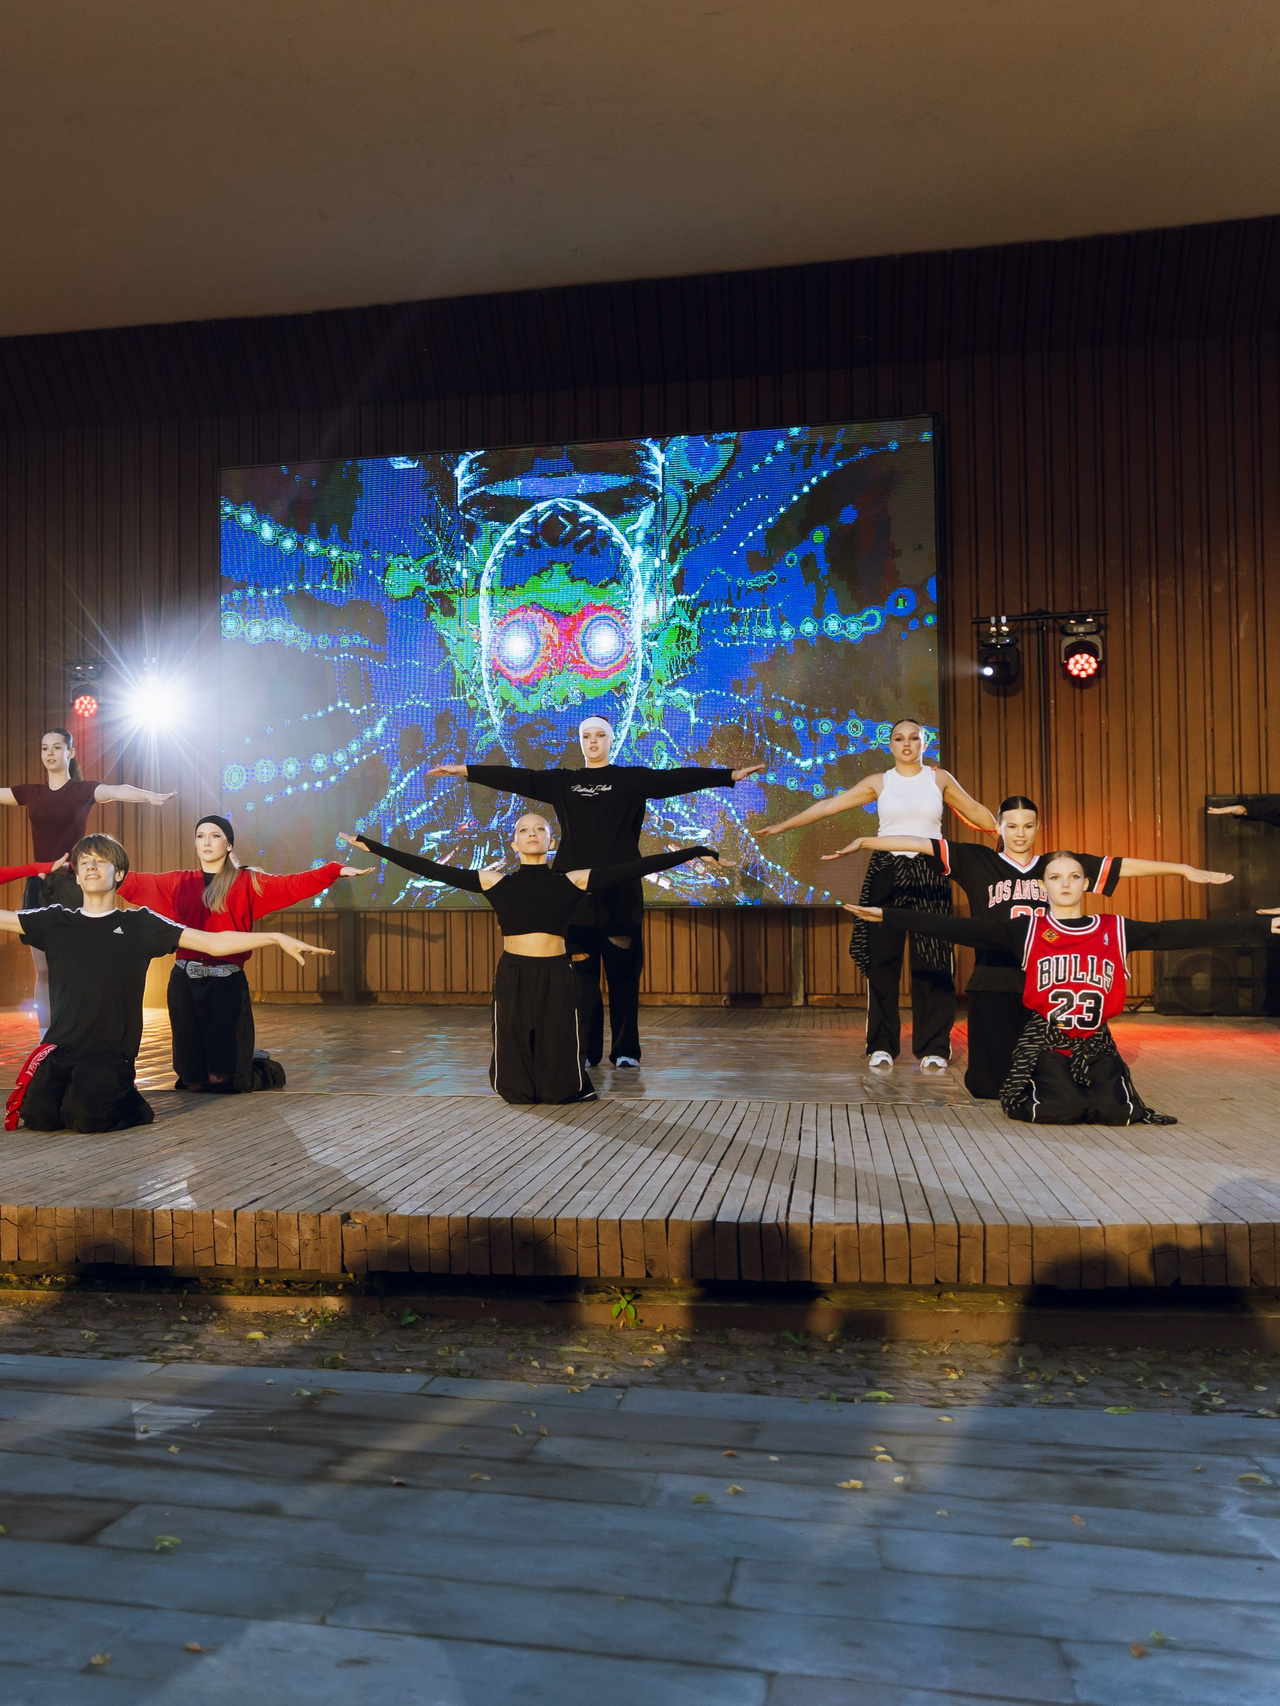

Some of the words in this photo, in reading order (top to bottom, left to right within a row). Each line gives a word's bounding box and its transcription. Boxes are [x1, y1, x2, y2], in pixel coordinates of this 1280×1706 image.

[988, 879, 1012, 908] LOS
[1037, 953, 1115, 994] BULLS
[1047, 988, 1105, 1030] 23
